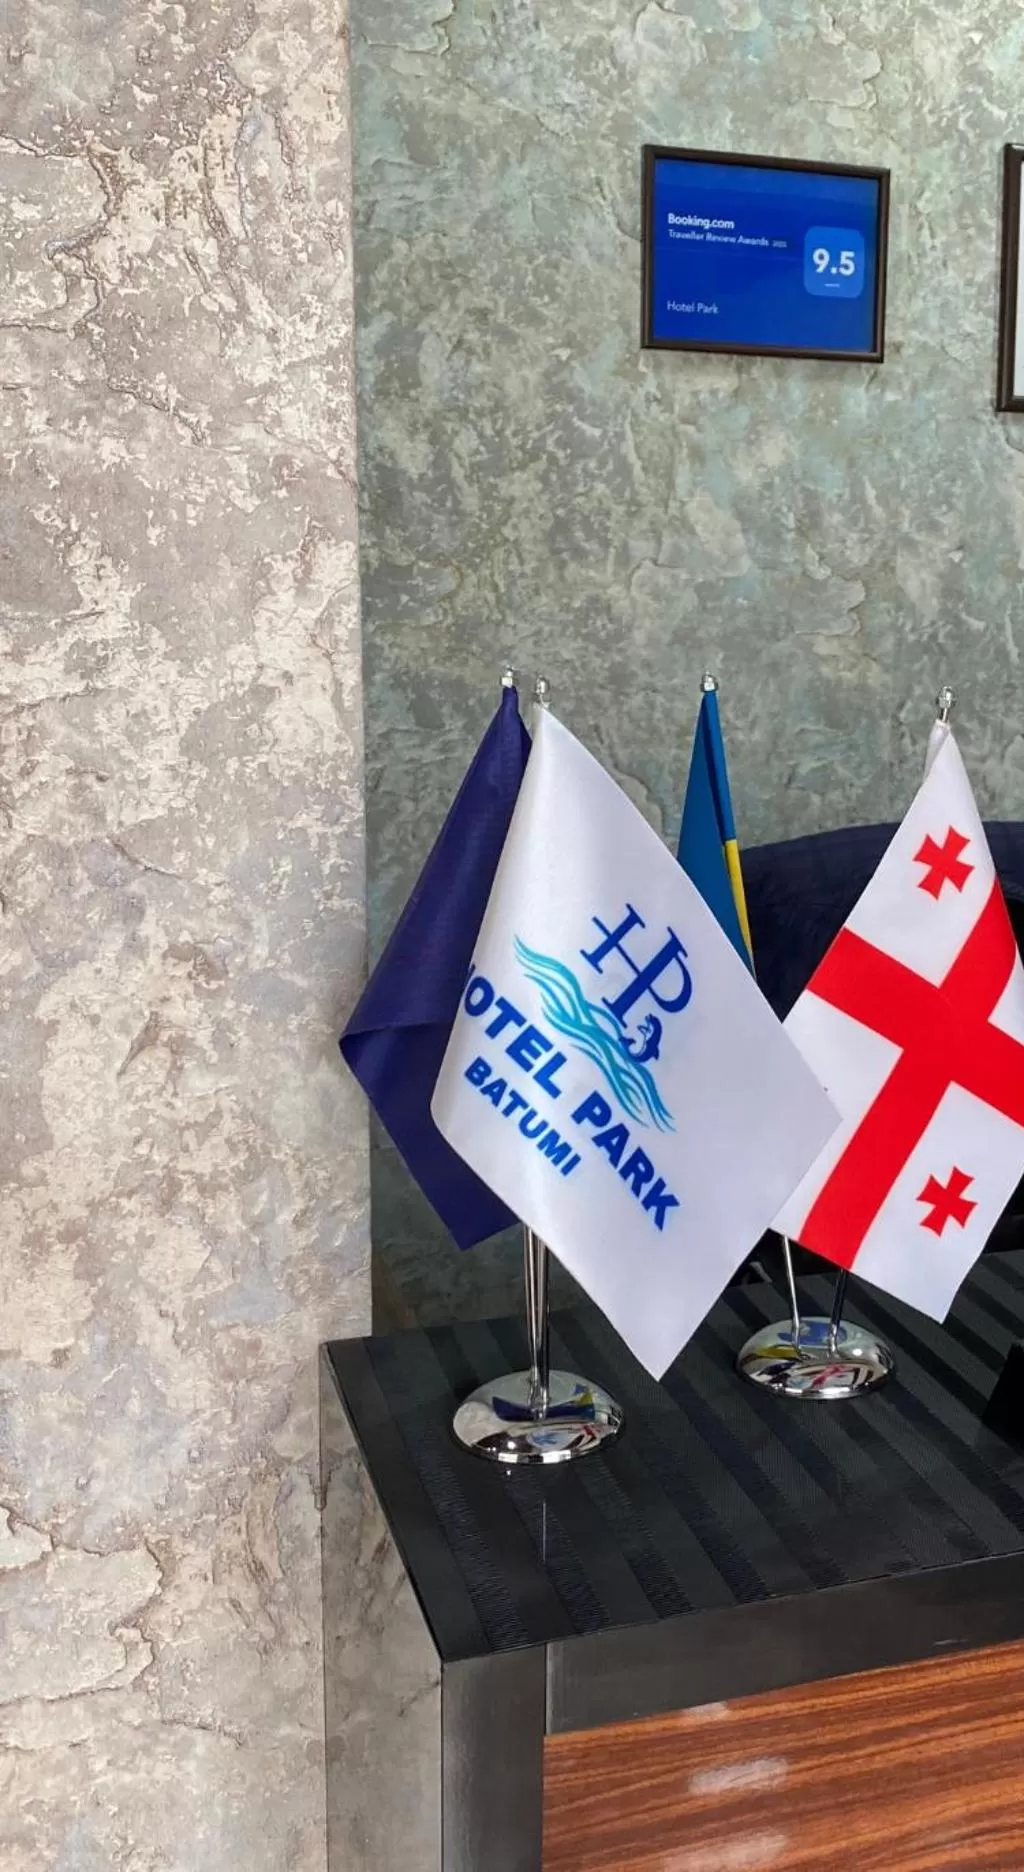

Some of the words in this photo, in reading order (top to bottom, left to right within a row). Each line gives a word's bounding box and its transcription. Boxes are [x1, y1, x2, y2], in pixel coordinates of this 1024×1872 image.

[668, 212, 735, 229] Booking.com
[705, 232, 737, 243] Review
[737, 236, 769, 246] Awards
[812, 248, 856, 276] 9.5
[667, 300, 695, 312] Hotel
[697, 302, 719, 314] Park
[464, 964, 567, 1099] OTEL
[570, 1090, 680, 1231] PARK
[464, 1056, 582, 1177] BATUMI
